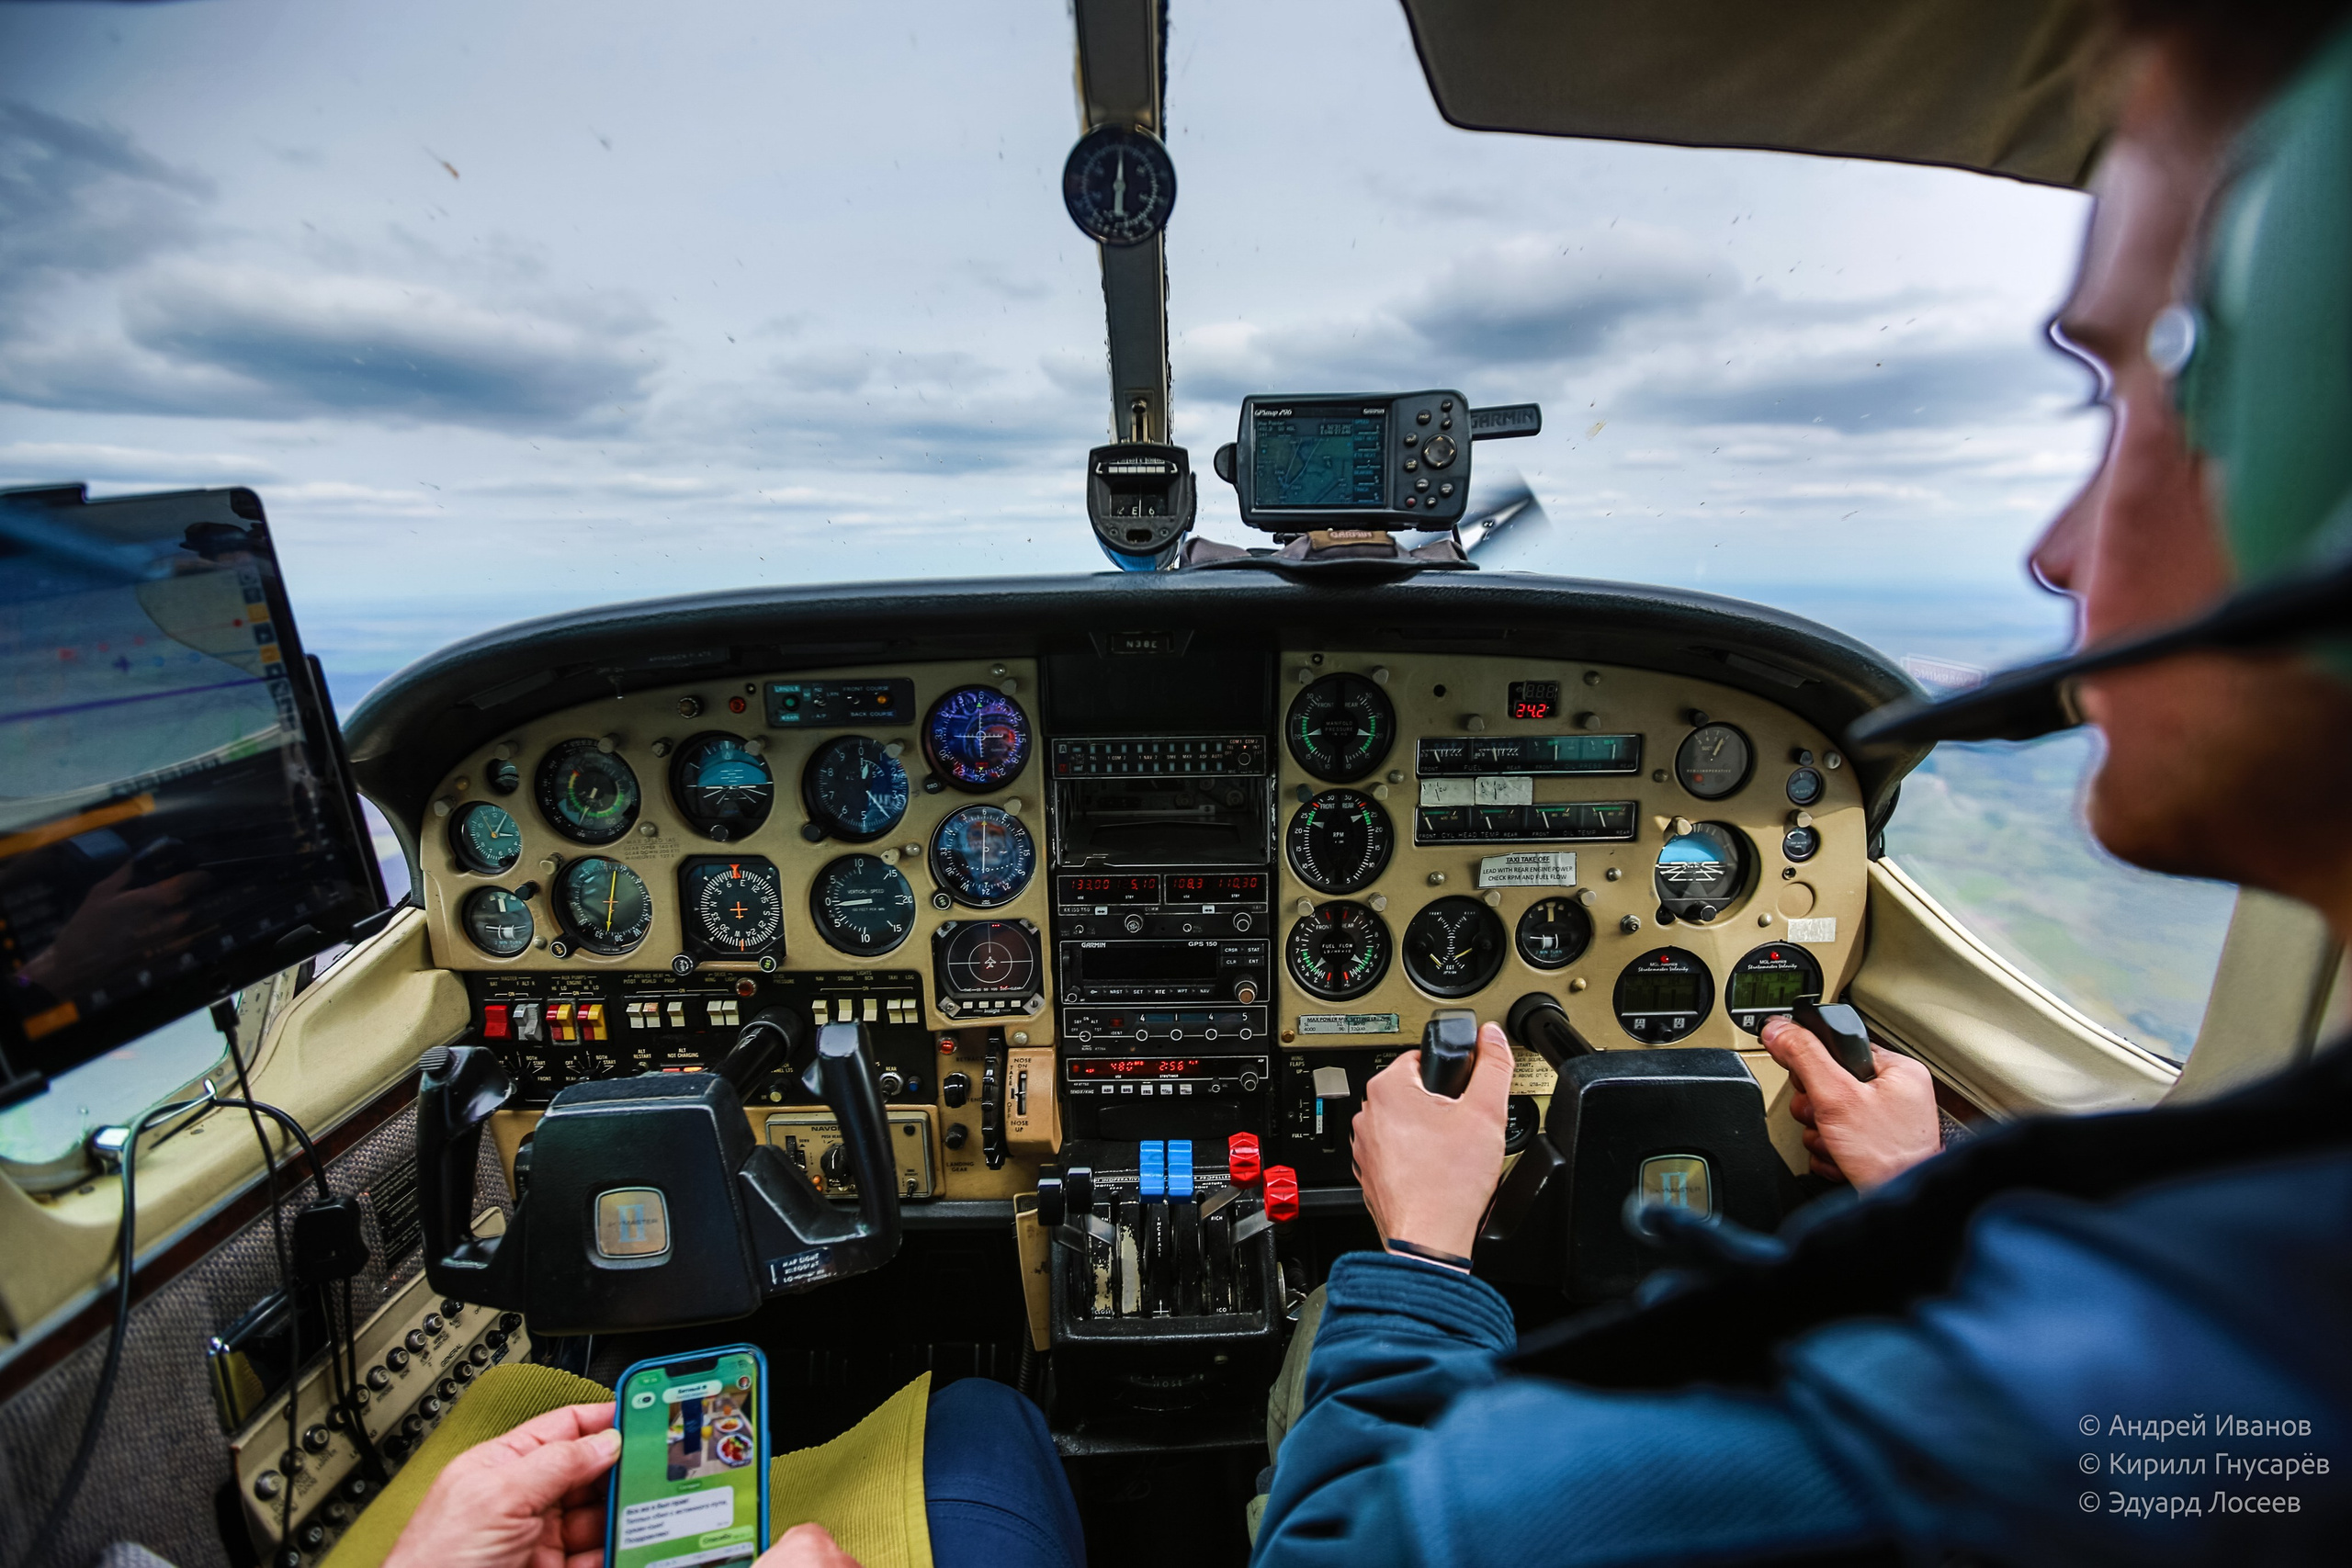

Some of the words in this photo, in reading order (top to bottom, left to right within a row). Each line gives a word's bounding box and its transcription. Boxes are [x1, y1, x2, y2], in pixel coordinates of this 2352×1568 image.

[1470, 408, 1535, 429] GARMIN
[1329, 530, 1373, 539] GARMIN
[1516, 703, 1547, 718] 24.2
[854, 859, 864, 867] 10
[888, 869, 898, 877] 15
[1071, 879, 1109, 890] 133.00
[1218, 877, 1257, 888] 110.30
[902, 896, 912, 904] 20
[893, 924, 901, 932] 15
[861, 934, 870, 942] 10
[1111, 1062, 1133, 1071] 480
[1159, 1061, 1183, 1071] 2:56
[440, 1343, 463, 1368] GENERAL
